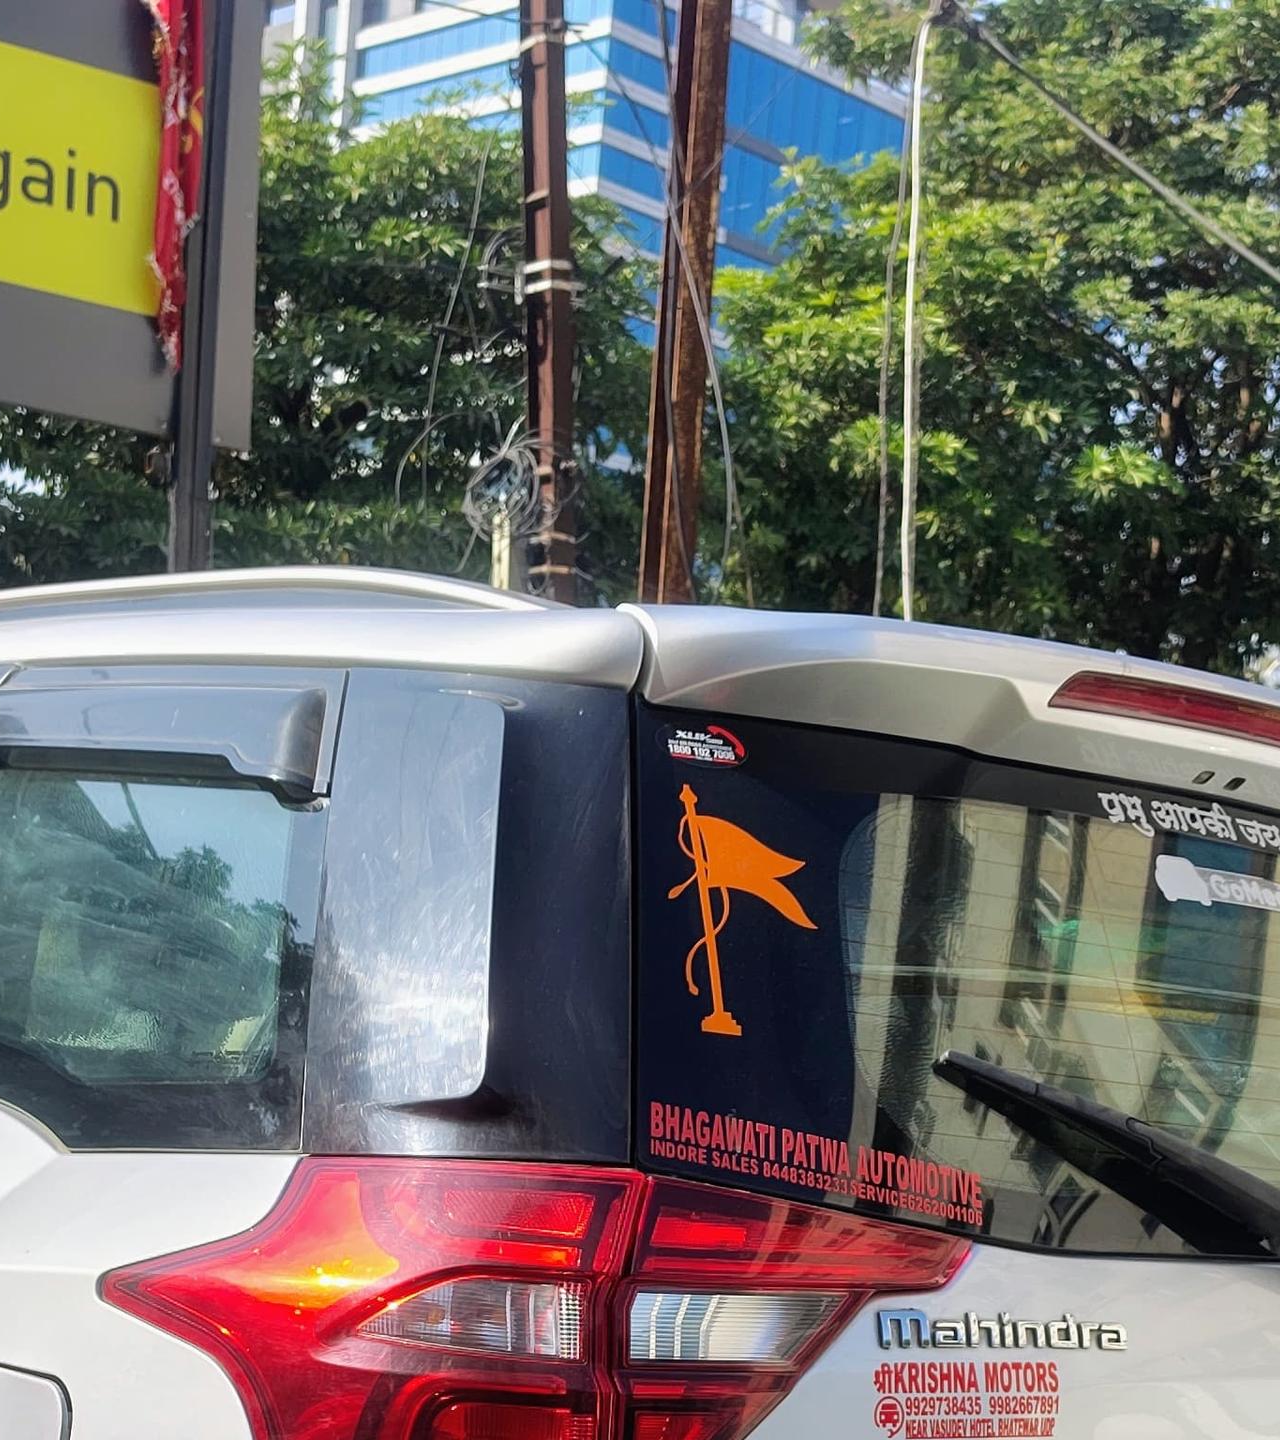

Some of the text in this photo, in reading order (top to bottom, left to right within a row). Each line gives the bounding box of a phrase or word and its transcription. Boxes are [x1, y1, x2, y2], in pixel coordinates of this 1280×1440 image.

[650, 1101, 983, 1210] BHAGAWATI PATWA AUTOMOTIVE
[650, 1138, 707, 1166] INDORE
[712, 1150, 759, 1176] SALES
[762, 1161, 848, 1194] 8448383233
[877, 1308, 1129, 1350] Mahindra
[984, 1362, 1060, 1393] MOTORS
[905, 1395, 1060, 1416] 9929738435 9982667891
[970, 1418, 996, 1437] HOTEL
